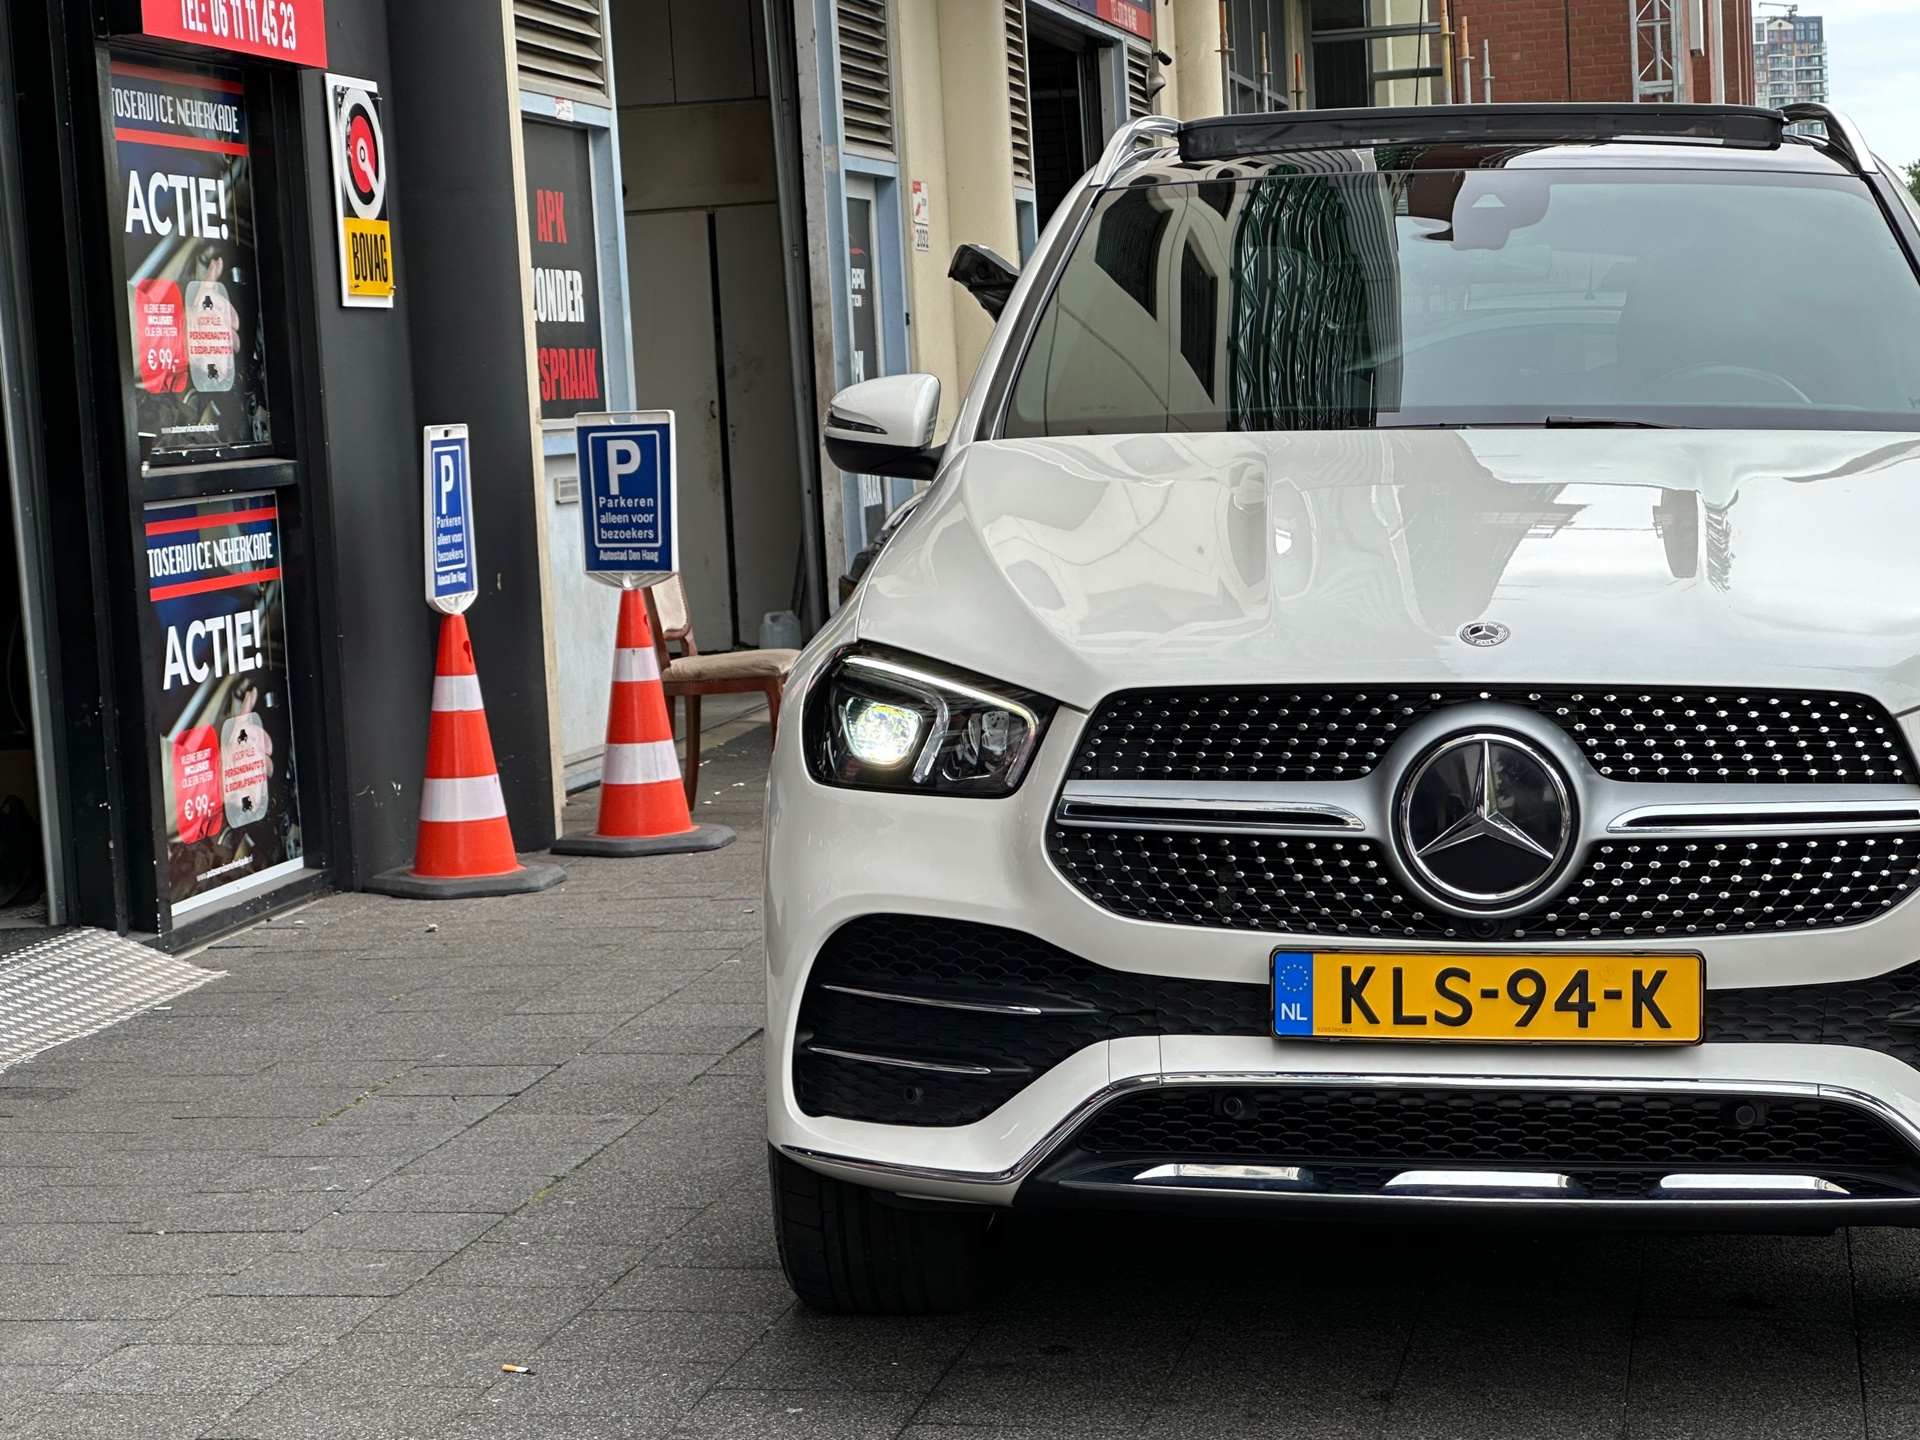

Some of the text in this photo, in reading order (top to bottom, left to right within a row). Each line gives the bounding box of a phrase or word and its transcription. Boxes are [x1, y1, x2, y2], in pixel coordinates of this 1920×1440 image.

[181, 0, 296, 50] TEL: 06 11 11 45 23
[176, 98, 240, 133] NEHERKADE
[125, 170, 228, 240] ACTIE!
[537, 189, 567, 244] APK
[351, 232, 388, 283] BOVAG
[440, 455, 454, 514] P
[606, 439, 641, 495] P
[598, 496, 654, 508] Parkeren
[599, 512, 654, 524] alleen voor
[437, 516, 461, 529] Parkeren
[437, 532, 463, 546] alleen voor
[600, 527, 654, 539] bezoekers
[213, 532, 273, 567] NEHERKADE
[437, 548, 464, 562] bezoekers
[599, 549, 659, 563] Autostad Den Haag
[163, 609, 263, 690] ACTIE!
[1281, 1002, 1308, 1021] NL
[1341, 965, 1672, 1029] KLS-94-K
